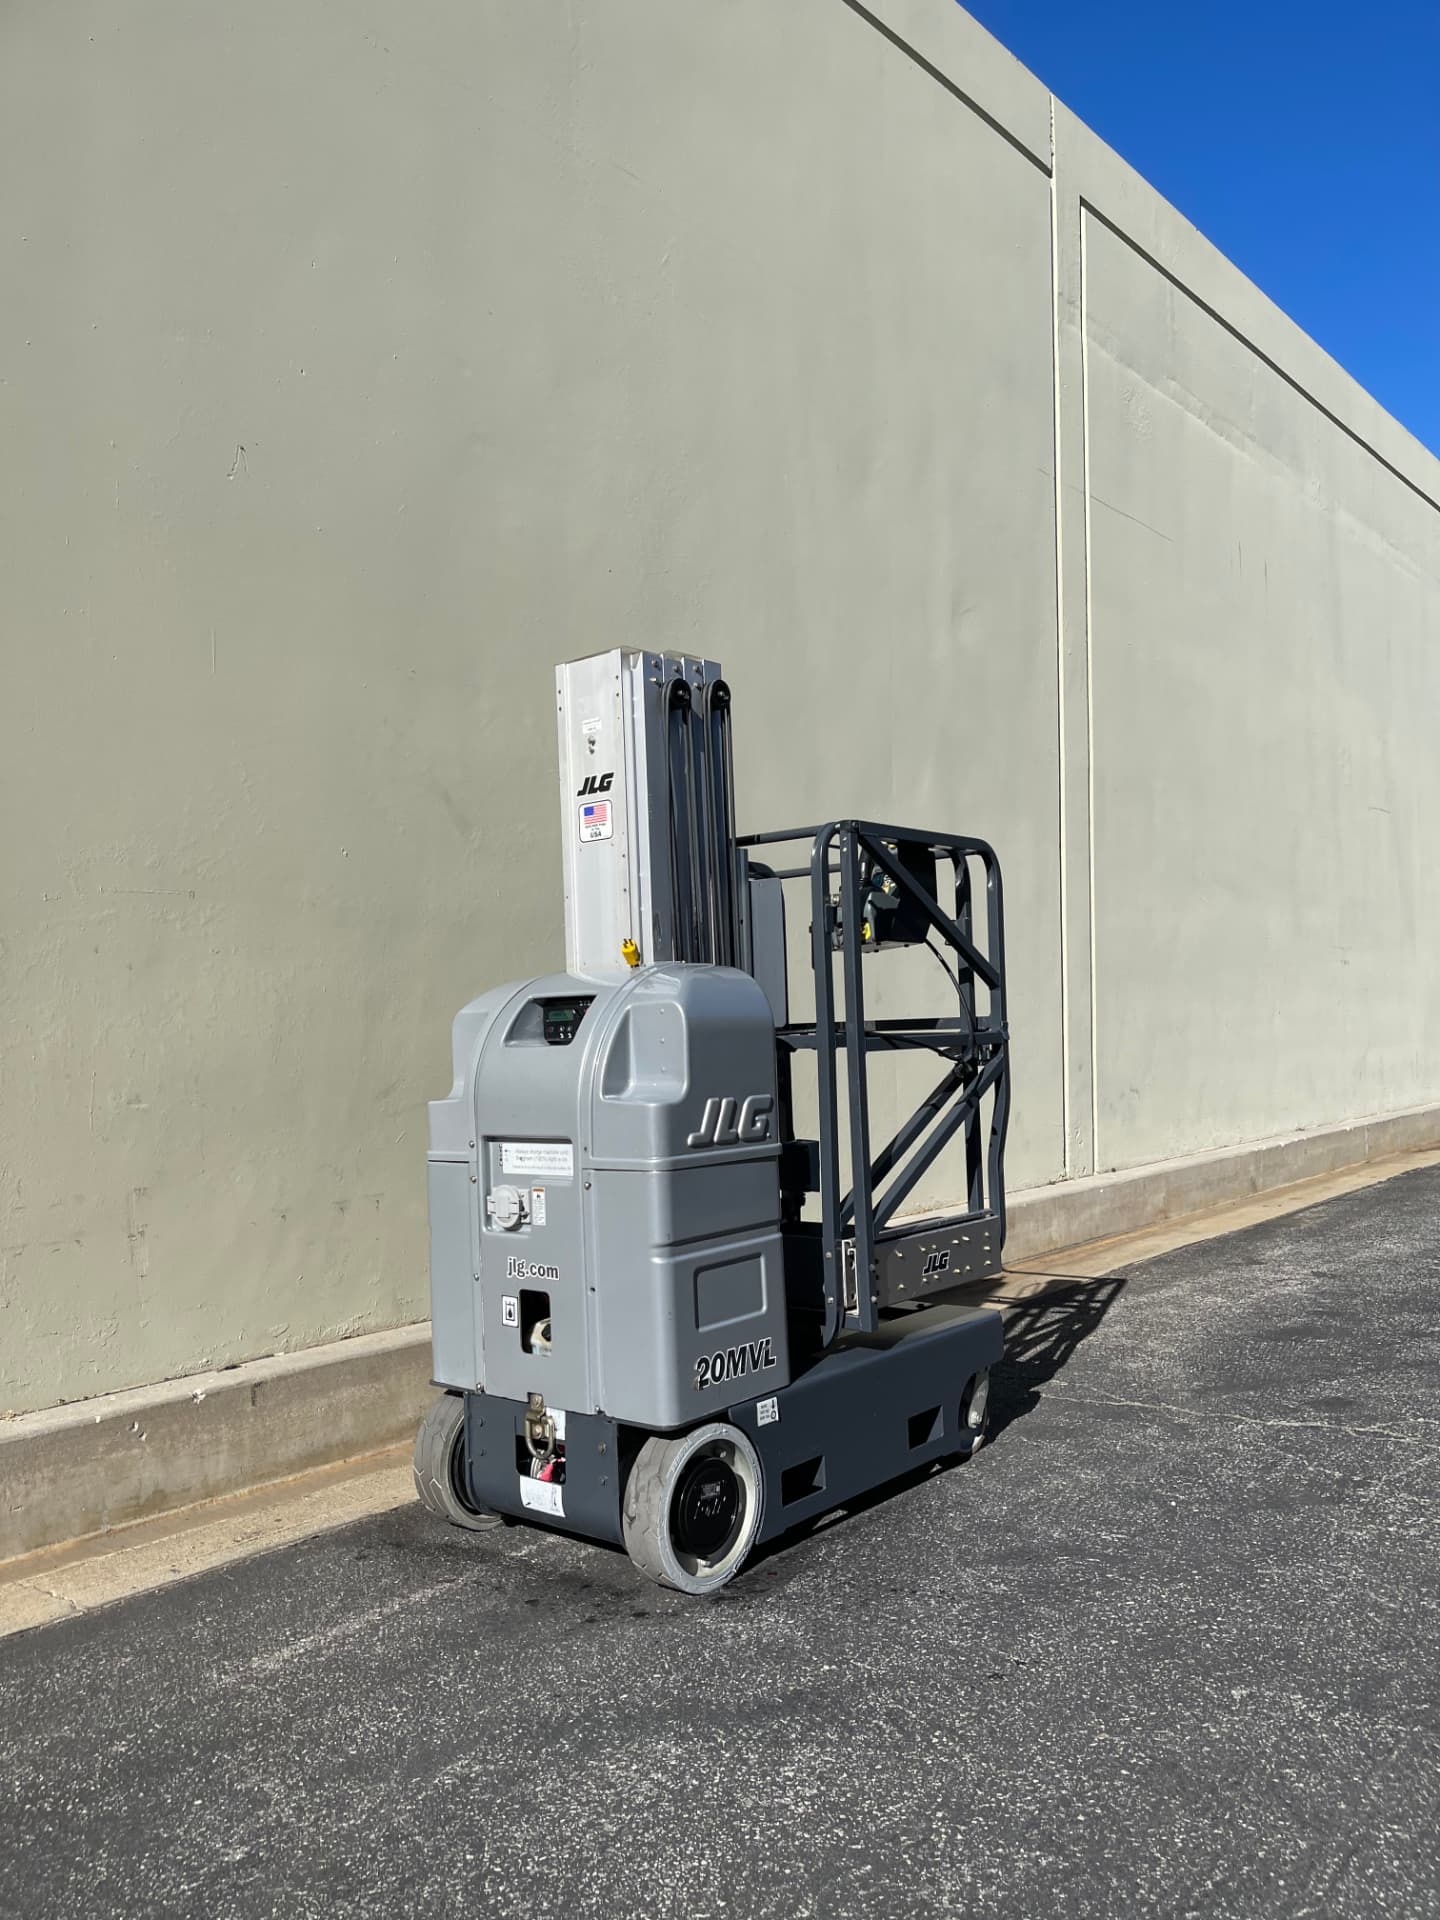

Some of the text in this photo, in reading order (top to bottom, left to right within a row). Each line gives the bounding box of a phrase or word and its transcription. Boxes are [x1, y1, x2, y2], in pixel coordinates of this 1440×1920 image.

[577, 772, 614, 796] JLG
[688, 1094, 774, 1148] JLG
[507, 1257, 560, 1280] jlg.com
[922, 1250, 950, 1275] JLG
[695, 1337, 776, 1391] 20MVL
